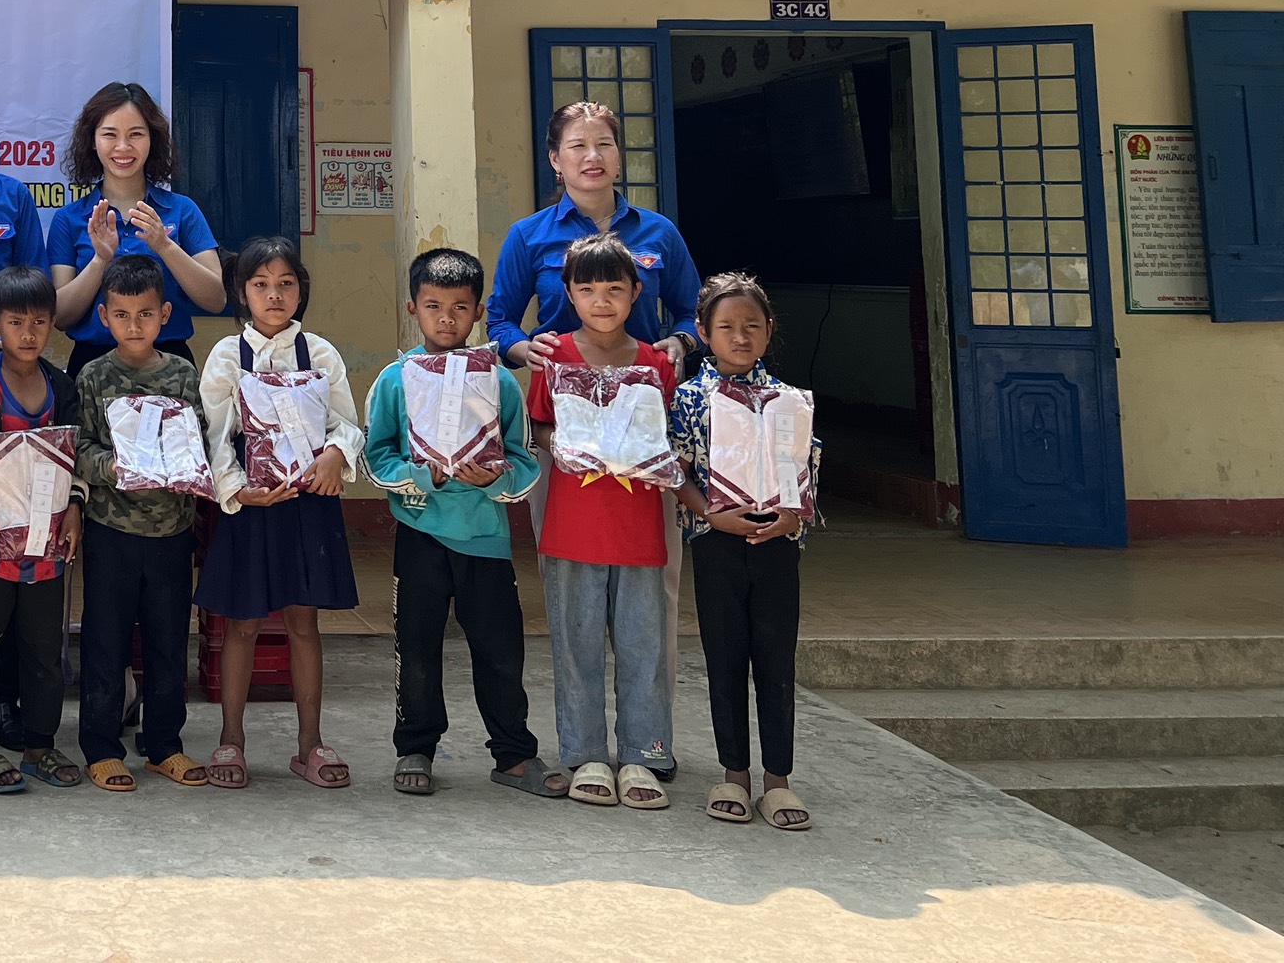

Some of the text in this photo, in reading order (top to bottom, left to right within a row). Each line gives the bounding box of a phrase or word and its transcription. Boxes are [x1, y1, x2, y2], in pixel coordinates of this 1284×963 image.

[776, 4, 826, 16] 3C 4C
[346, 148, 370, 158] LỆNH
